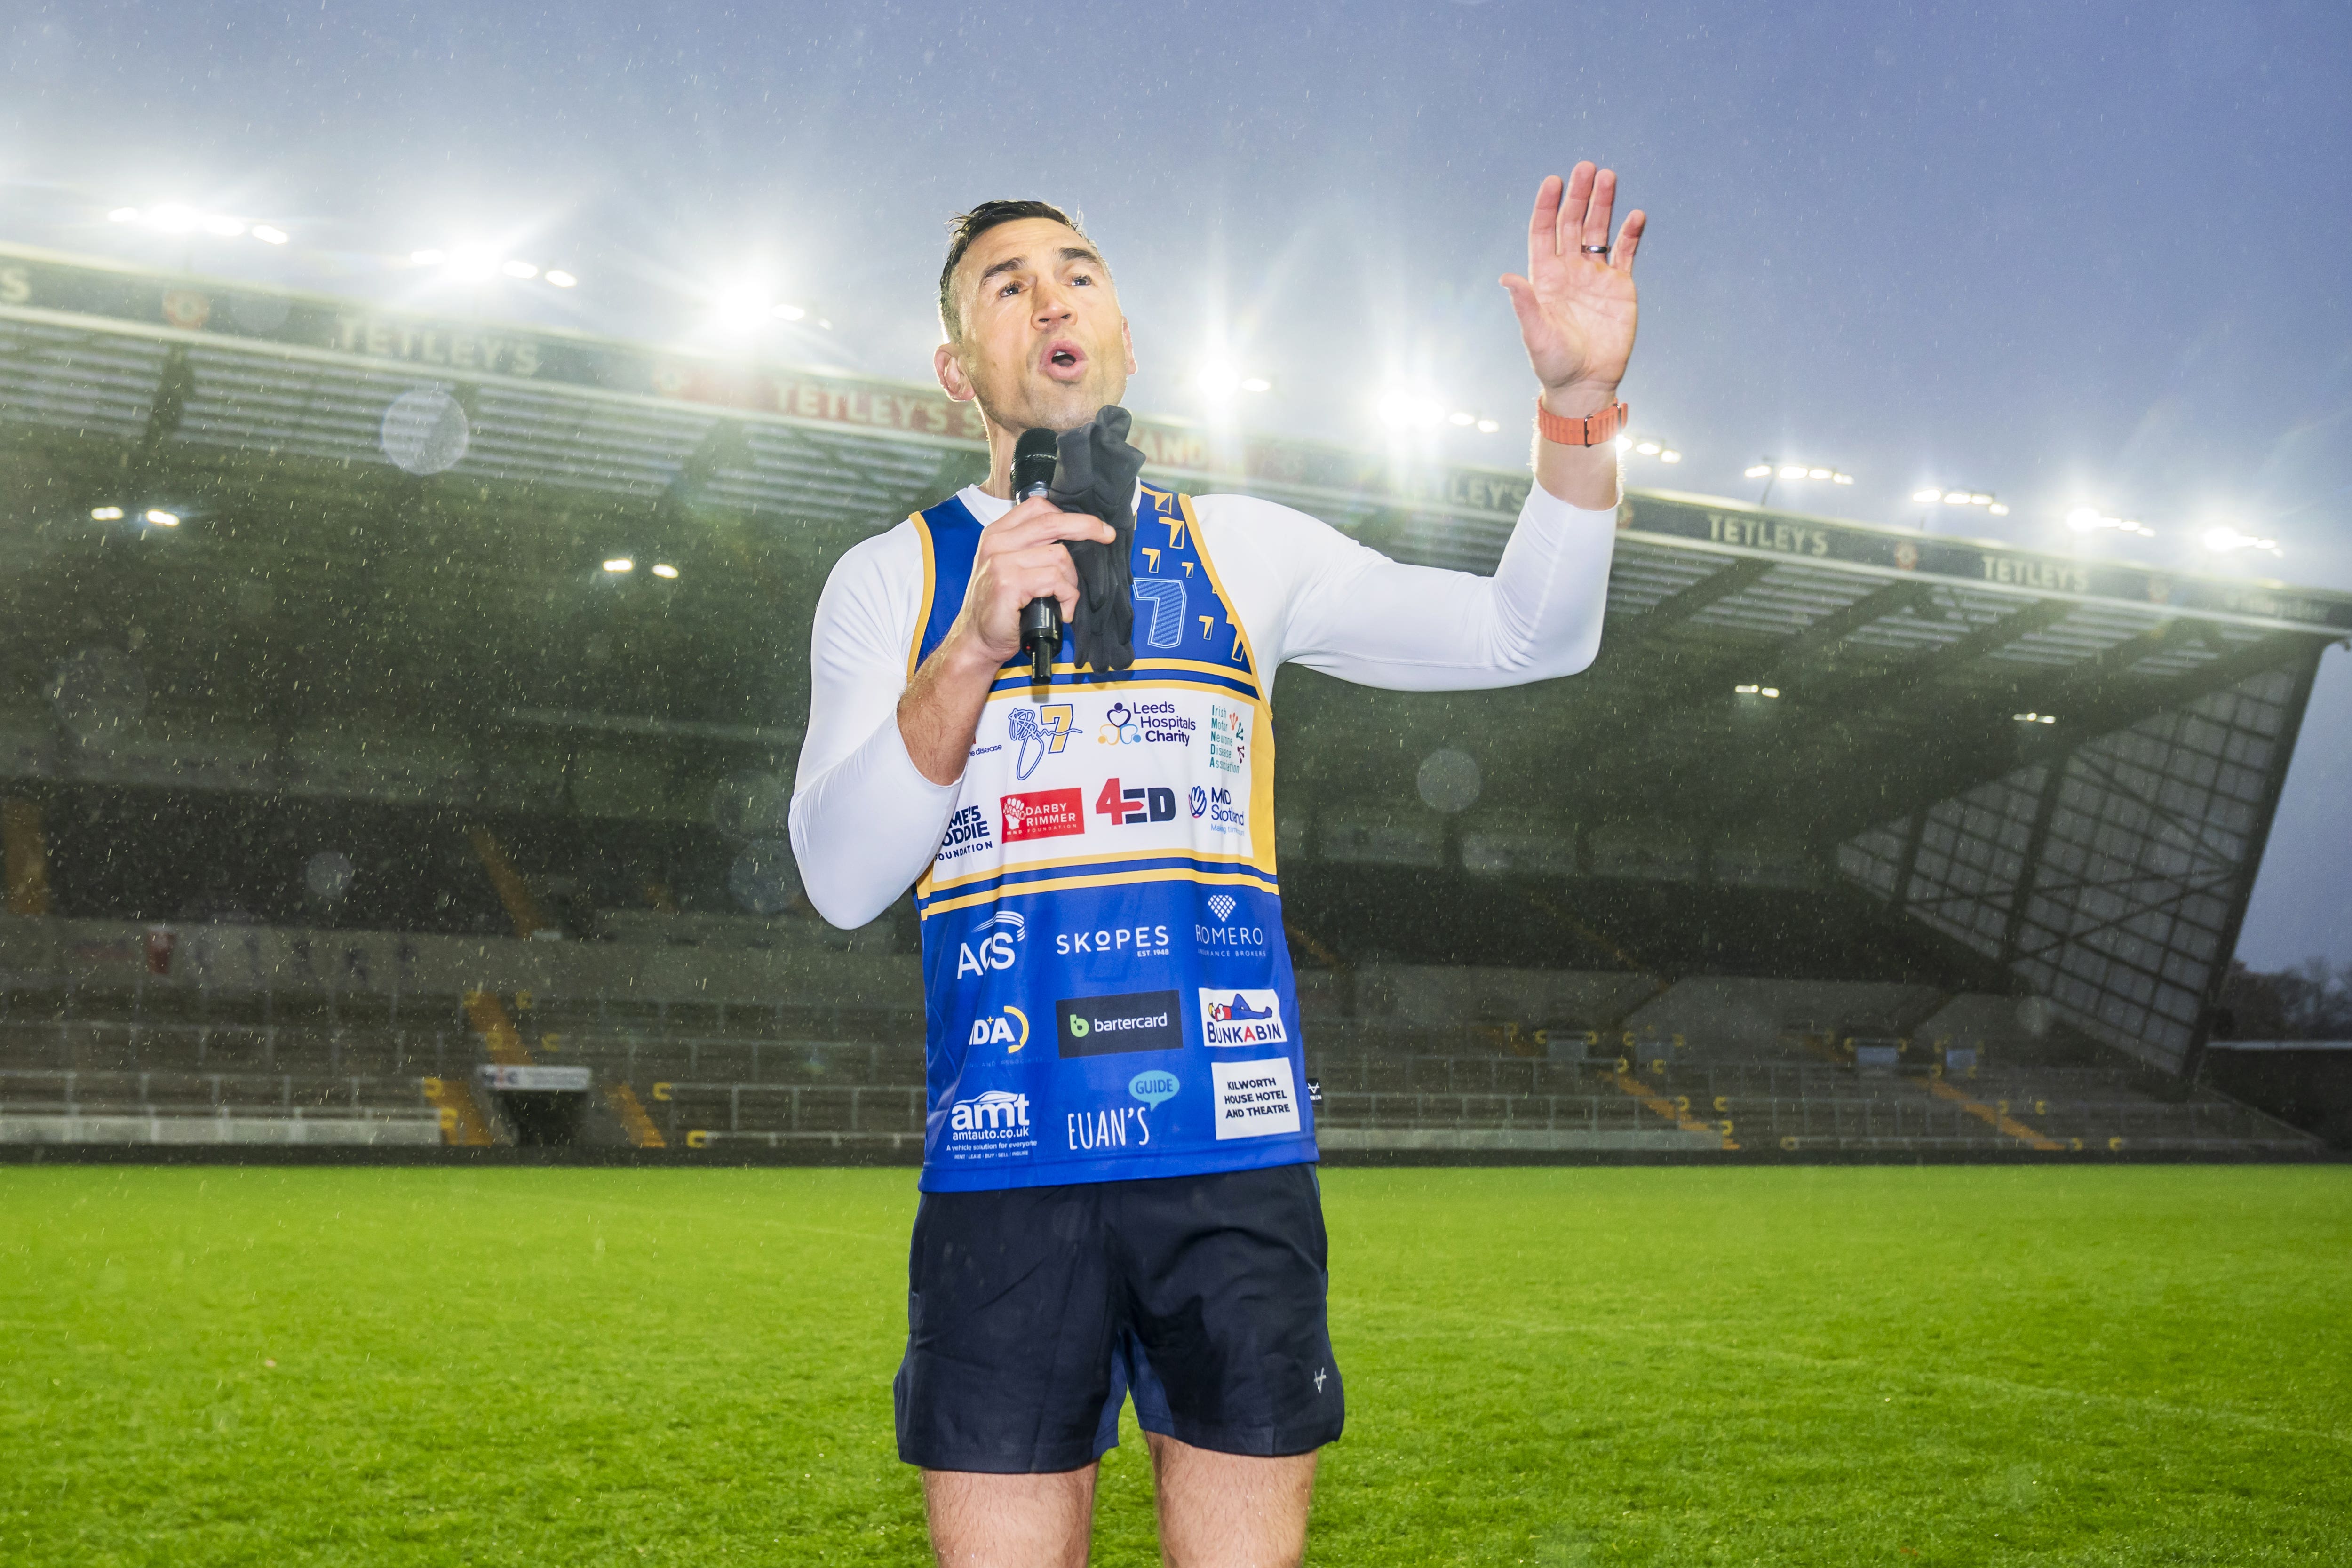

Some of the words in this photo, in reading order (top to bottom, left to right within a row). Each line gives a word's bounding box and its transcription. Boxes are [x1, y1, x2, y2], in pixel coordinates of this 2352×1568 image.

[772, 380, 947, 431] TETLEY'S
[1133, 701, 1175, 714] Leeds
[1212, 705, 1226, 718] Irish
[1040, 704, 1073, 754] 7
[1140, 716, 1196, 731] Hospitals
[1211, 718, 1228, 732] Motor
[1145, 730, 1190, 747] Charity
[1211, 731, 1233, 747] Neurone
[976, 745, 1002, 755] disease
[1210, 744, 1232, 758] Disease
[1025, 803, 1066, 816] DARBY
[1026, 812, 1076, 827] RIMMER
[1027, 824, 1077, 833] FOUNDATION
[1056, 925, 1169, 955] SKOPES
[1195, 924, 1263, 945] ROMERO
[957, 932, 1015, 979] ACS
[1094, 1012, 1168, 1032] bartercard
[1207, 1022, 1281, 1043] BUNKABIN
[1136, 1079, 1173, 1094] GUIDE
[1227, 1077, 1276, 1090] KILWORTH
[1224, 1094, 1254, 1105] HOUSE
[1255, 1090, 1287, 1102] HOTEL
[951, 1093, 1030, 1130] amt
[1225, 1109, 1245, 1119] AND
[1247, 1104, 1291, 1117] THEATRE
[953, 1126, 1029, 1141] amtauto.co.uk
[1068, 1107, 1149, 1150] EUAN'S
